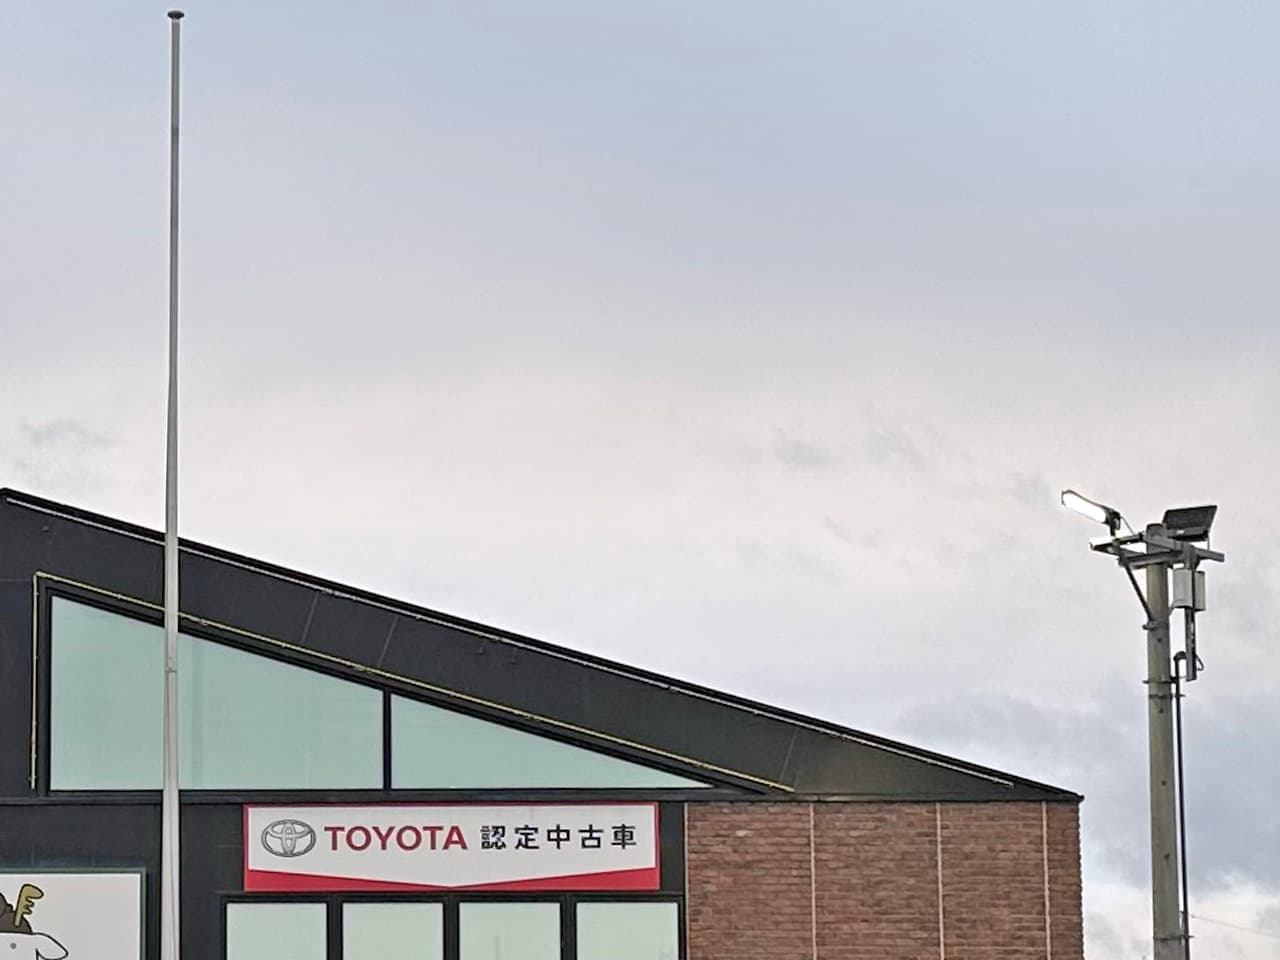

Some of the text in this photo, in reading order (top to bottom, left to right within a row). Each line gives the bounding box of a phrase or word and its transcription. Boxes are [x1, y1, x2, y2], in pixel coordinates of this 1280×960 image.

[324, 823, 638, 851] TOYOTA 認定中古車
